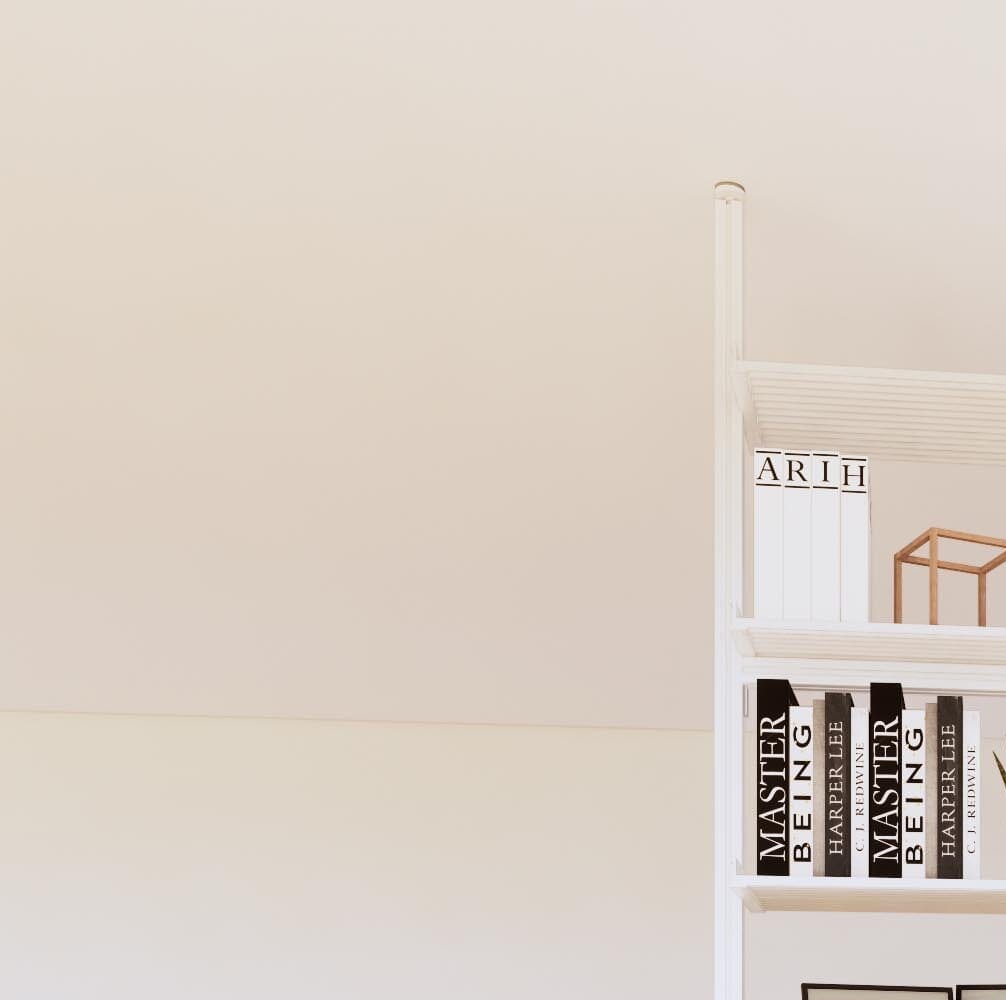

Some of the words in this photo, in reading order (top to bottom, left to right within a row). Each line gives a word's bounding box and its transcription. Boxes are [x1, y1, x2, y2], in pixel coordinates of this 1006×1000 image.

[829, 721, 844, 760] LEE
[855, 742, 865, 816] REDWINE
[941, 724, 956, 761] LEE
[967, 745, 976, 818] REDWINE
[759, 712, 786, 862] MASTER
[793, 725, 812, 862] BEING
[829, 766, 844, 855] HARPER
[872, 716, 899, 864] MASTER
[905, 728, 924, 864] BEING
[941, 767, 956, 857] HARPER
